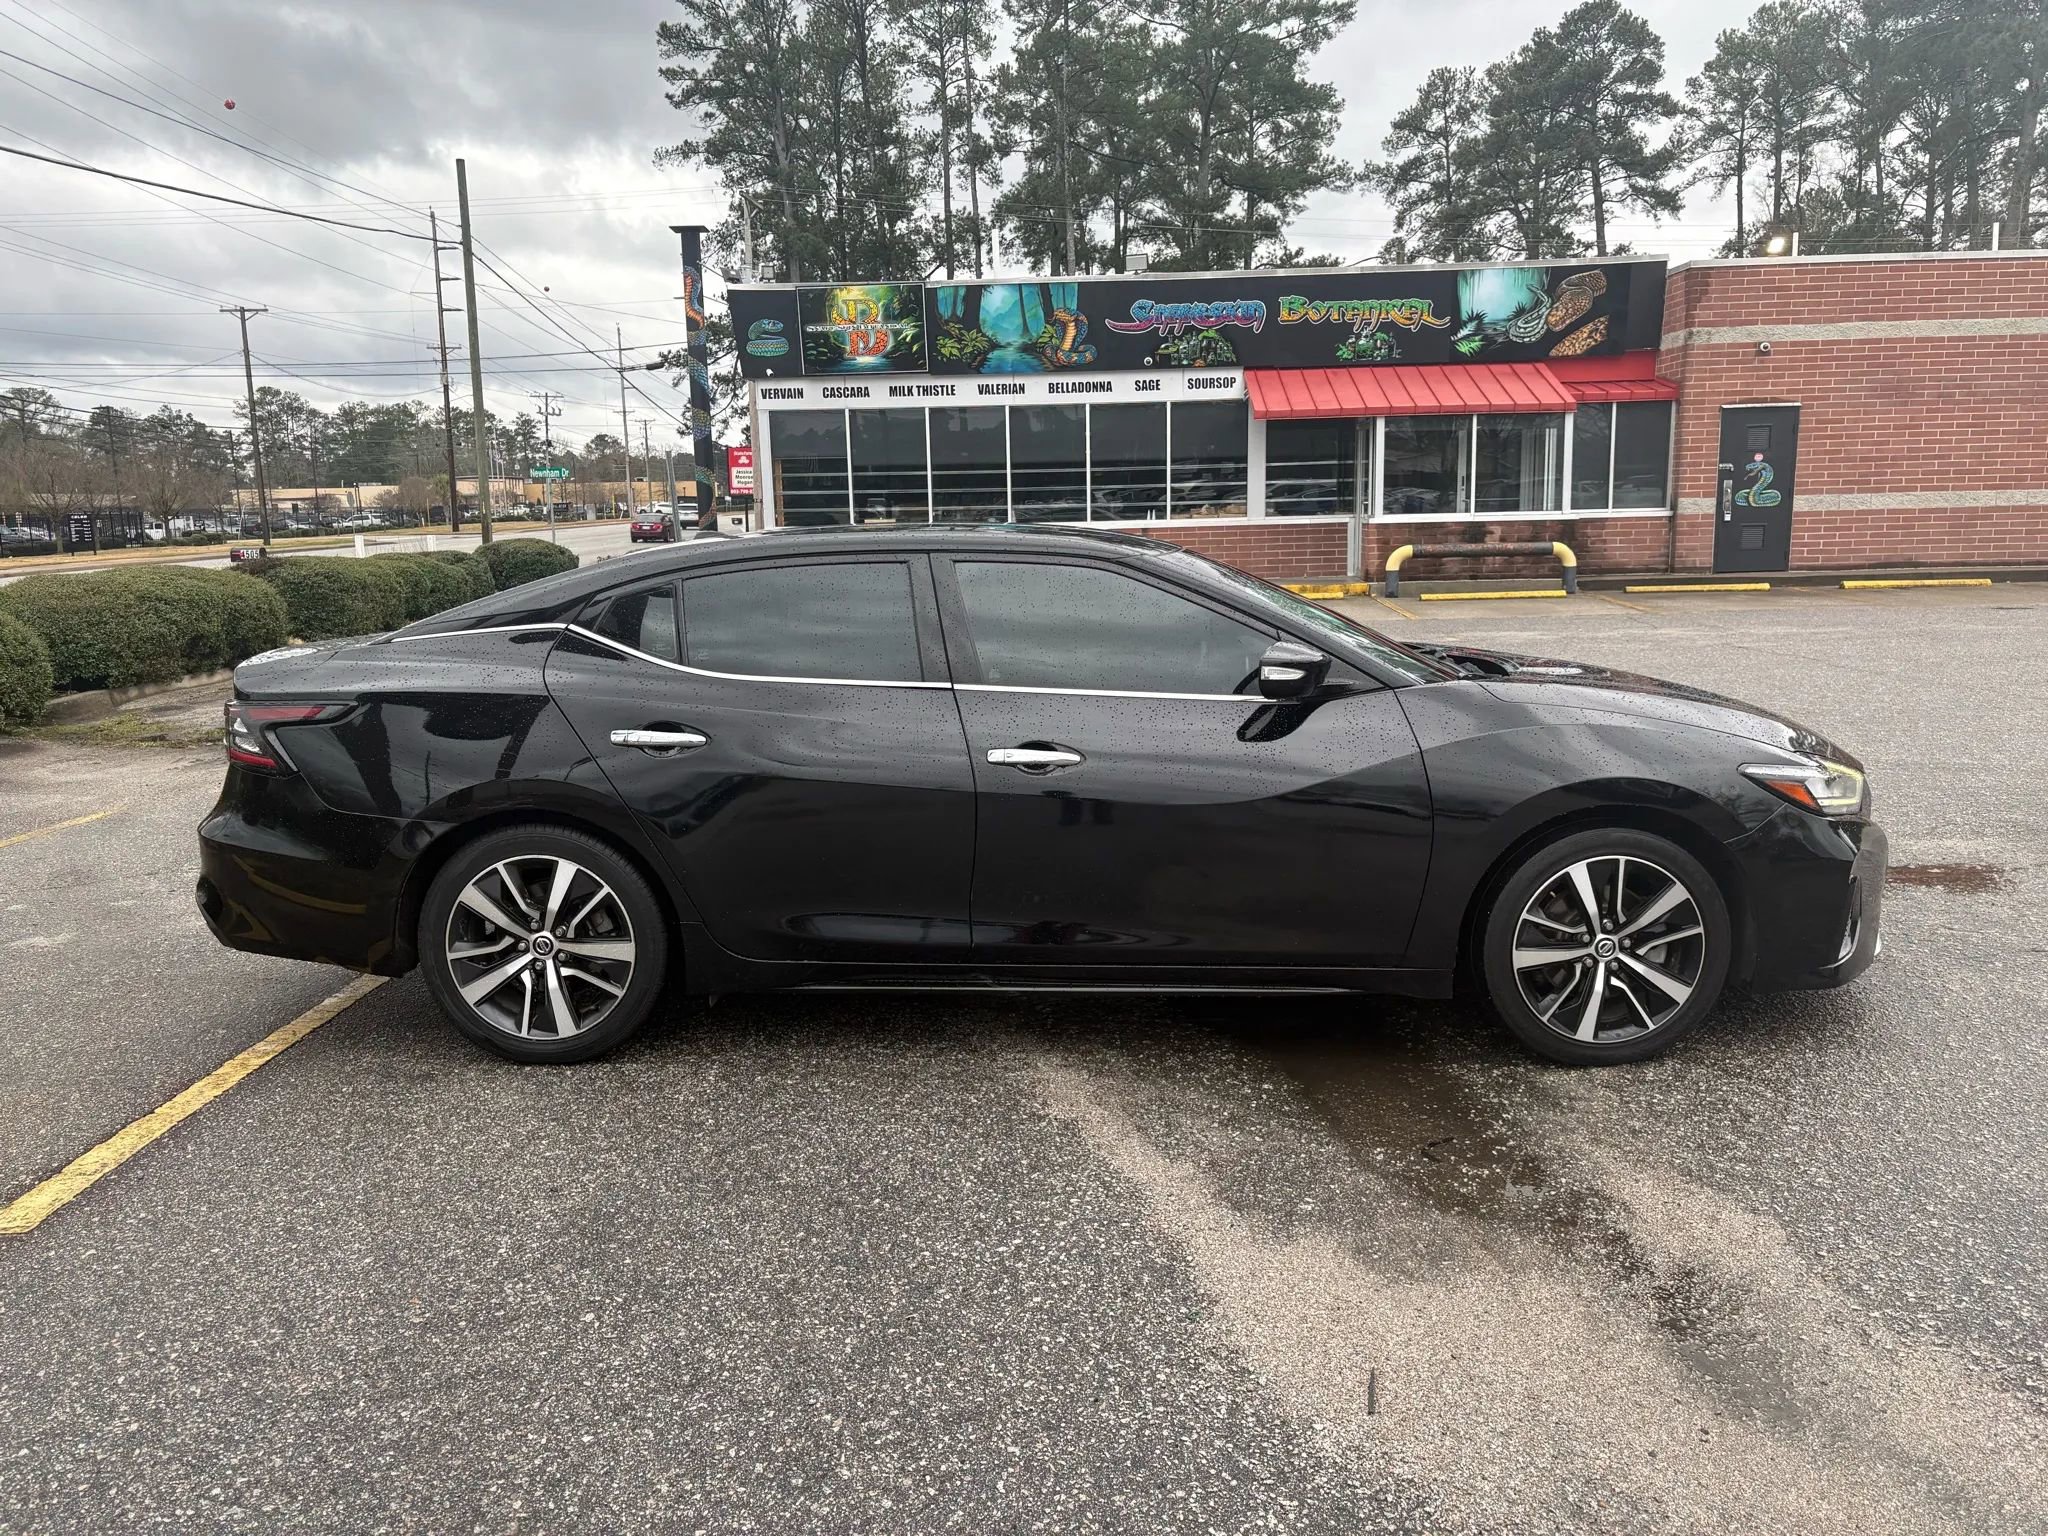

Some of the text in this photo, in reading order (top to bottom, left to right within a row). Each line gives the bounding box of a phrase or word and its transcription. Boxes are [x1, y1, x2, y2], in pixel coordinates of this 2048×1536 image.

[761, 377, 1237, 400] VERVAIN CASCARA MILK THISTLE VALERIAN BELLADONNA SAGE SOURSOP
[530, 468, 569, 478] Newnham Dr
